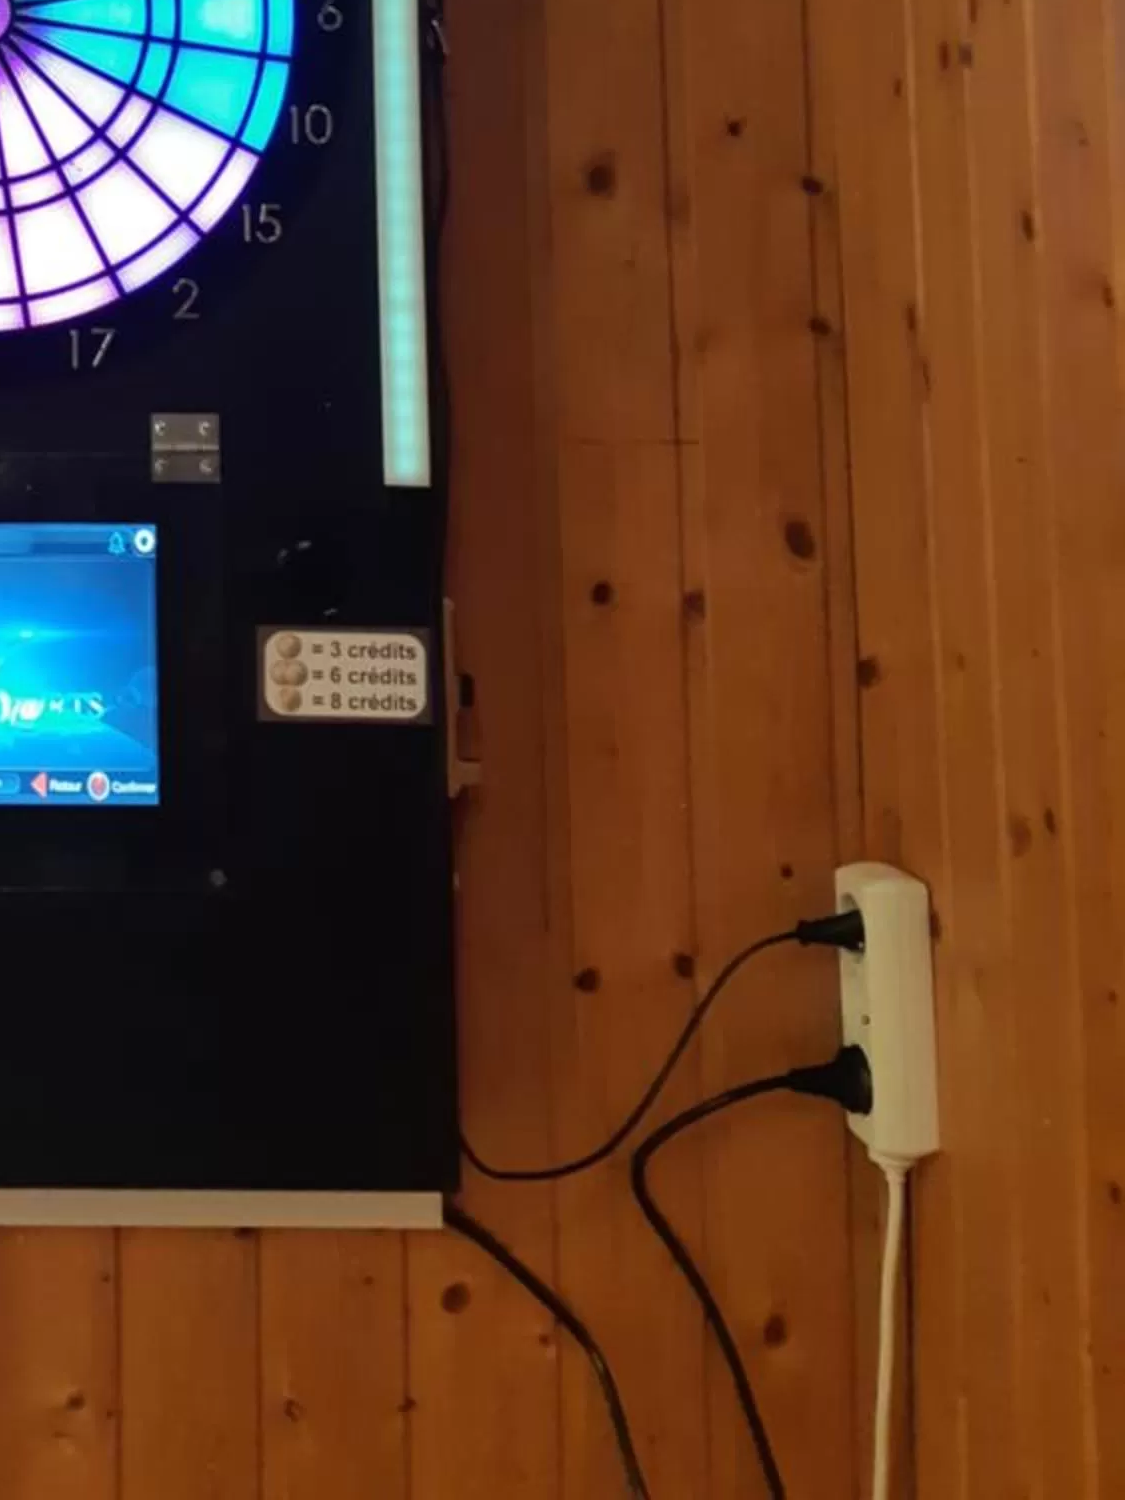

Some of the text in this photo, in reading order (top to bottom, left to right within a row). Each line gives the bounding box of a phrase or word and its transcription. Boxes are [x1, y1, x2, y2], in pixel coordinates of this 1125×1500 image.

[289, 103, 334, 145] 10
[242, 203, 283, 244] 15
[172, 278, 200, 319] 2
[69, 327, 116, 370] 17
[330, 640, 342, 659] 3
[347, 642, 418, 661] crédits
[330, 666, 342, 684] 6
[347, 667, 418, 685] crédits
[330, 692, 342, 710] 8
[348, 693, 418, 711] crédits
